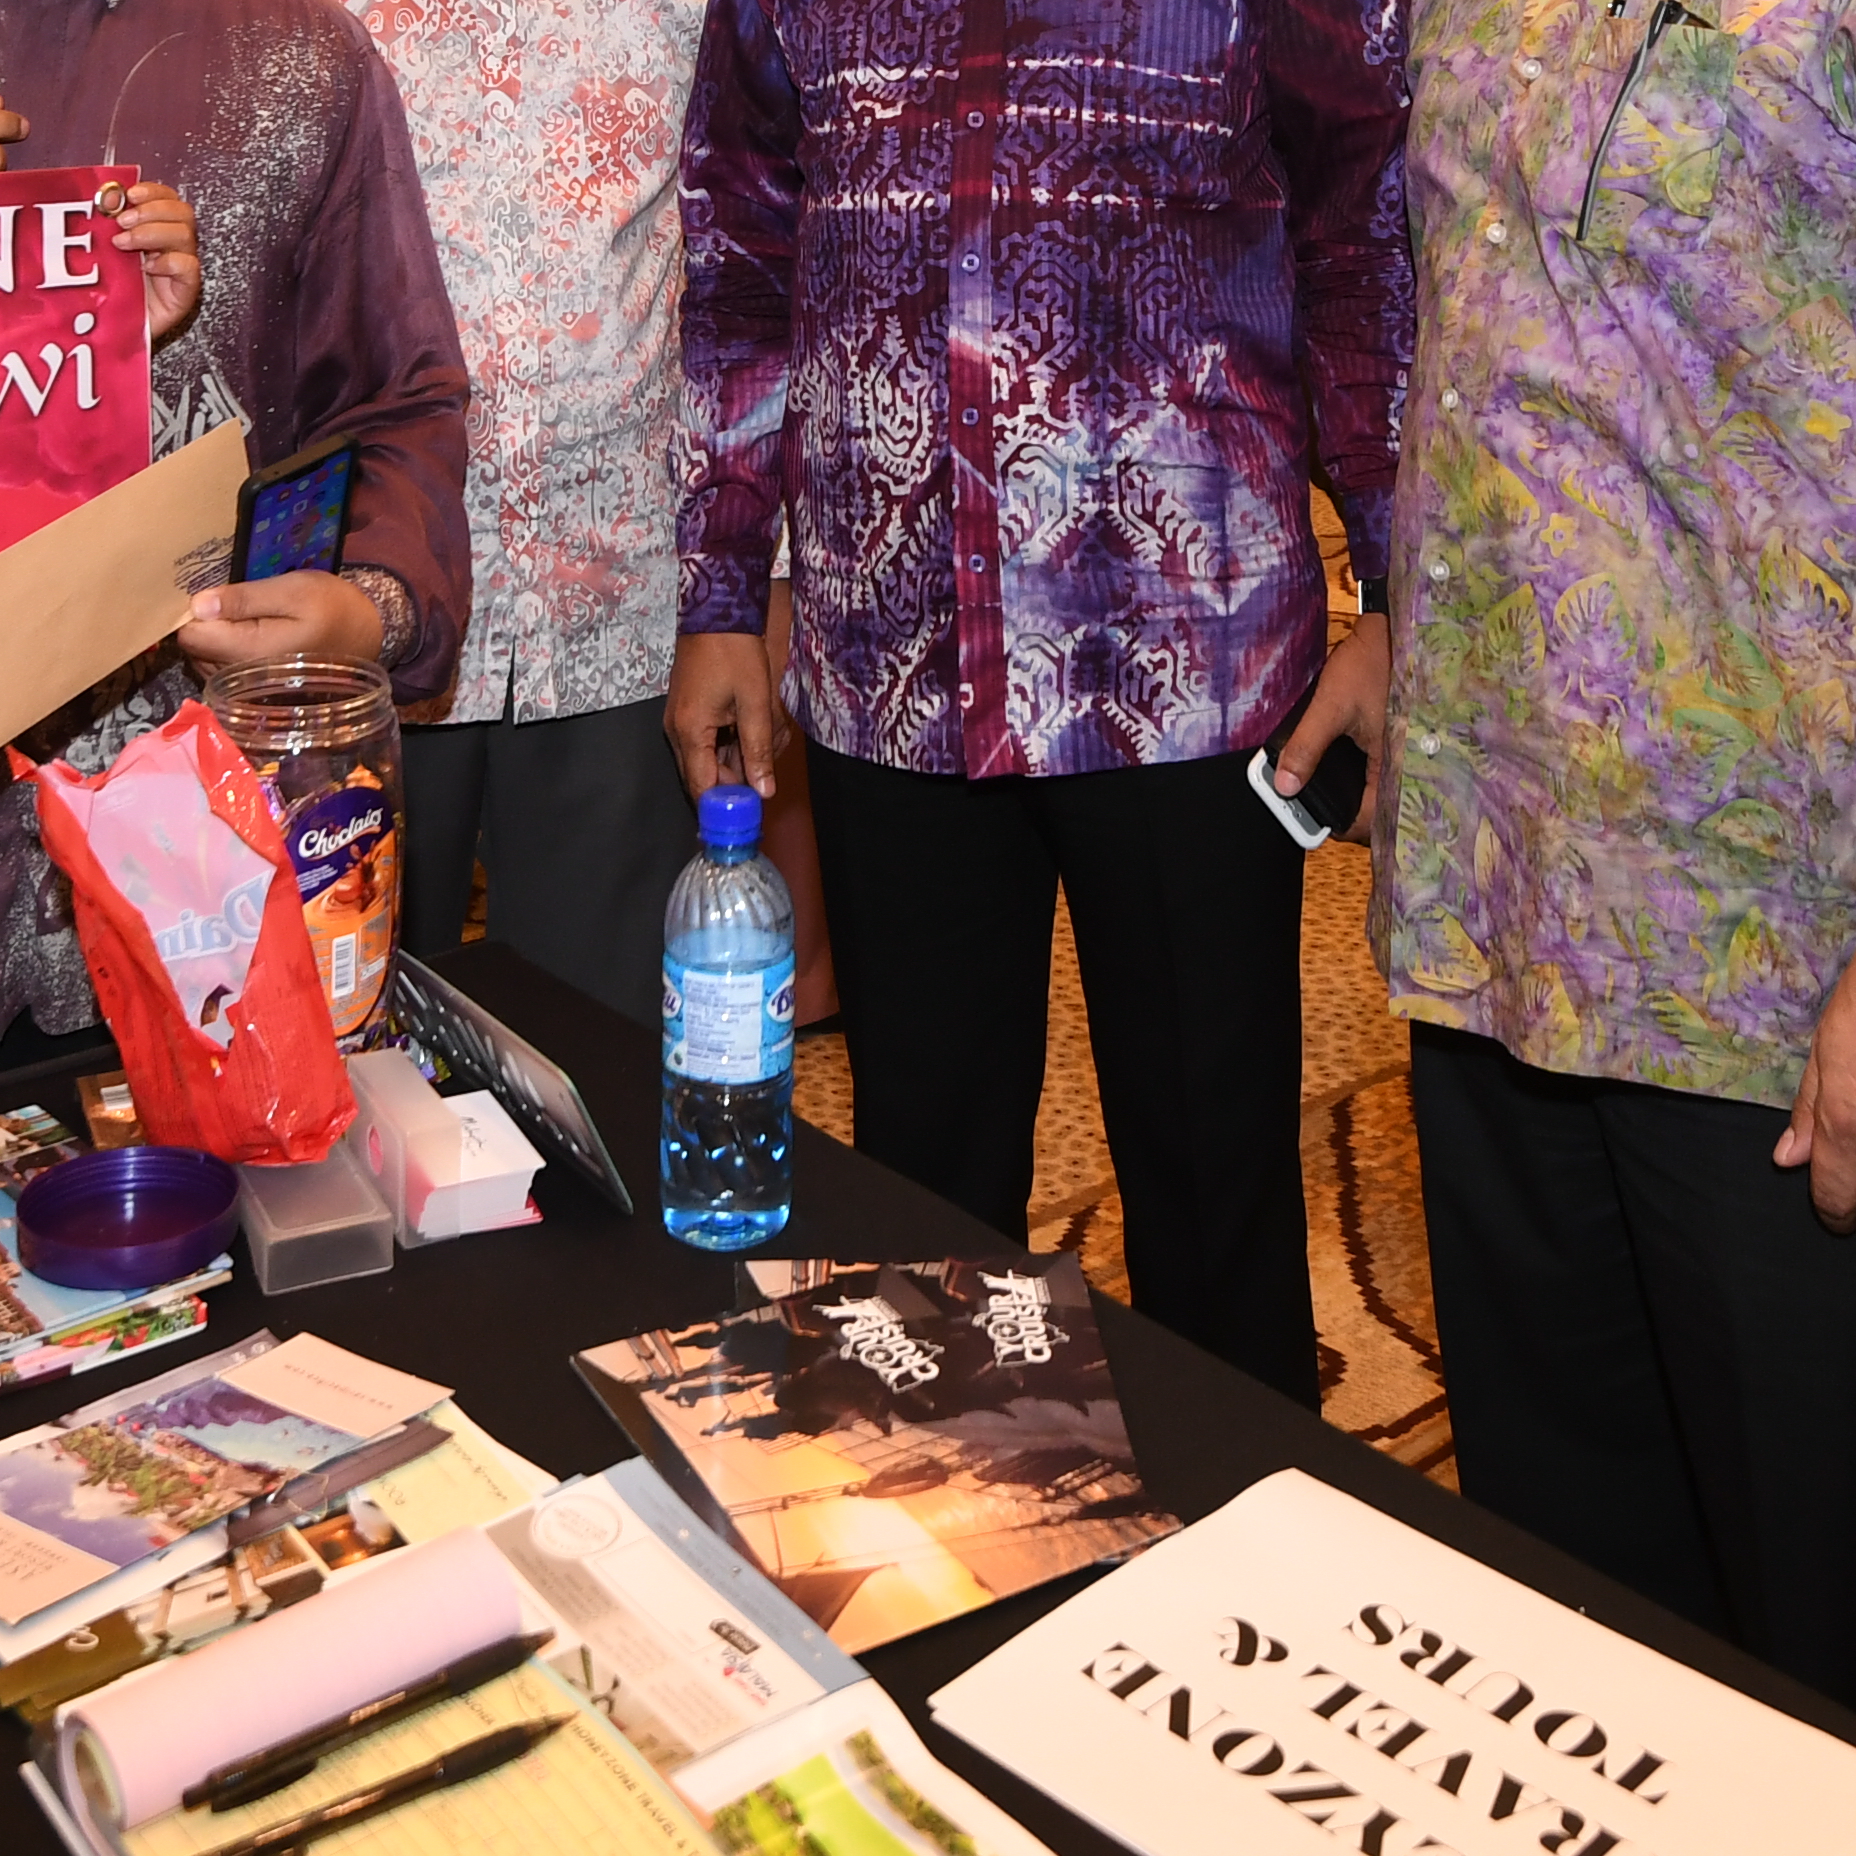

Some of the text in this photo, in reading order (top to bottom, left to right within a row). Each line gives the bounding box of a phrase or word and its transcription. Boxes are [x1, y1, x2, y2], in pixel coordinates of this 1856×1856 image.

[987, 1294, 1024, 1360] YOUR
[1014, 1293, 1052, 1363] CRUISE
[1212, 1616, 1289, 1667] &
[1343, 1602, 1676, 1806] TOURS
[569, 1722, 637, 1793] HONEYZONE
